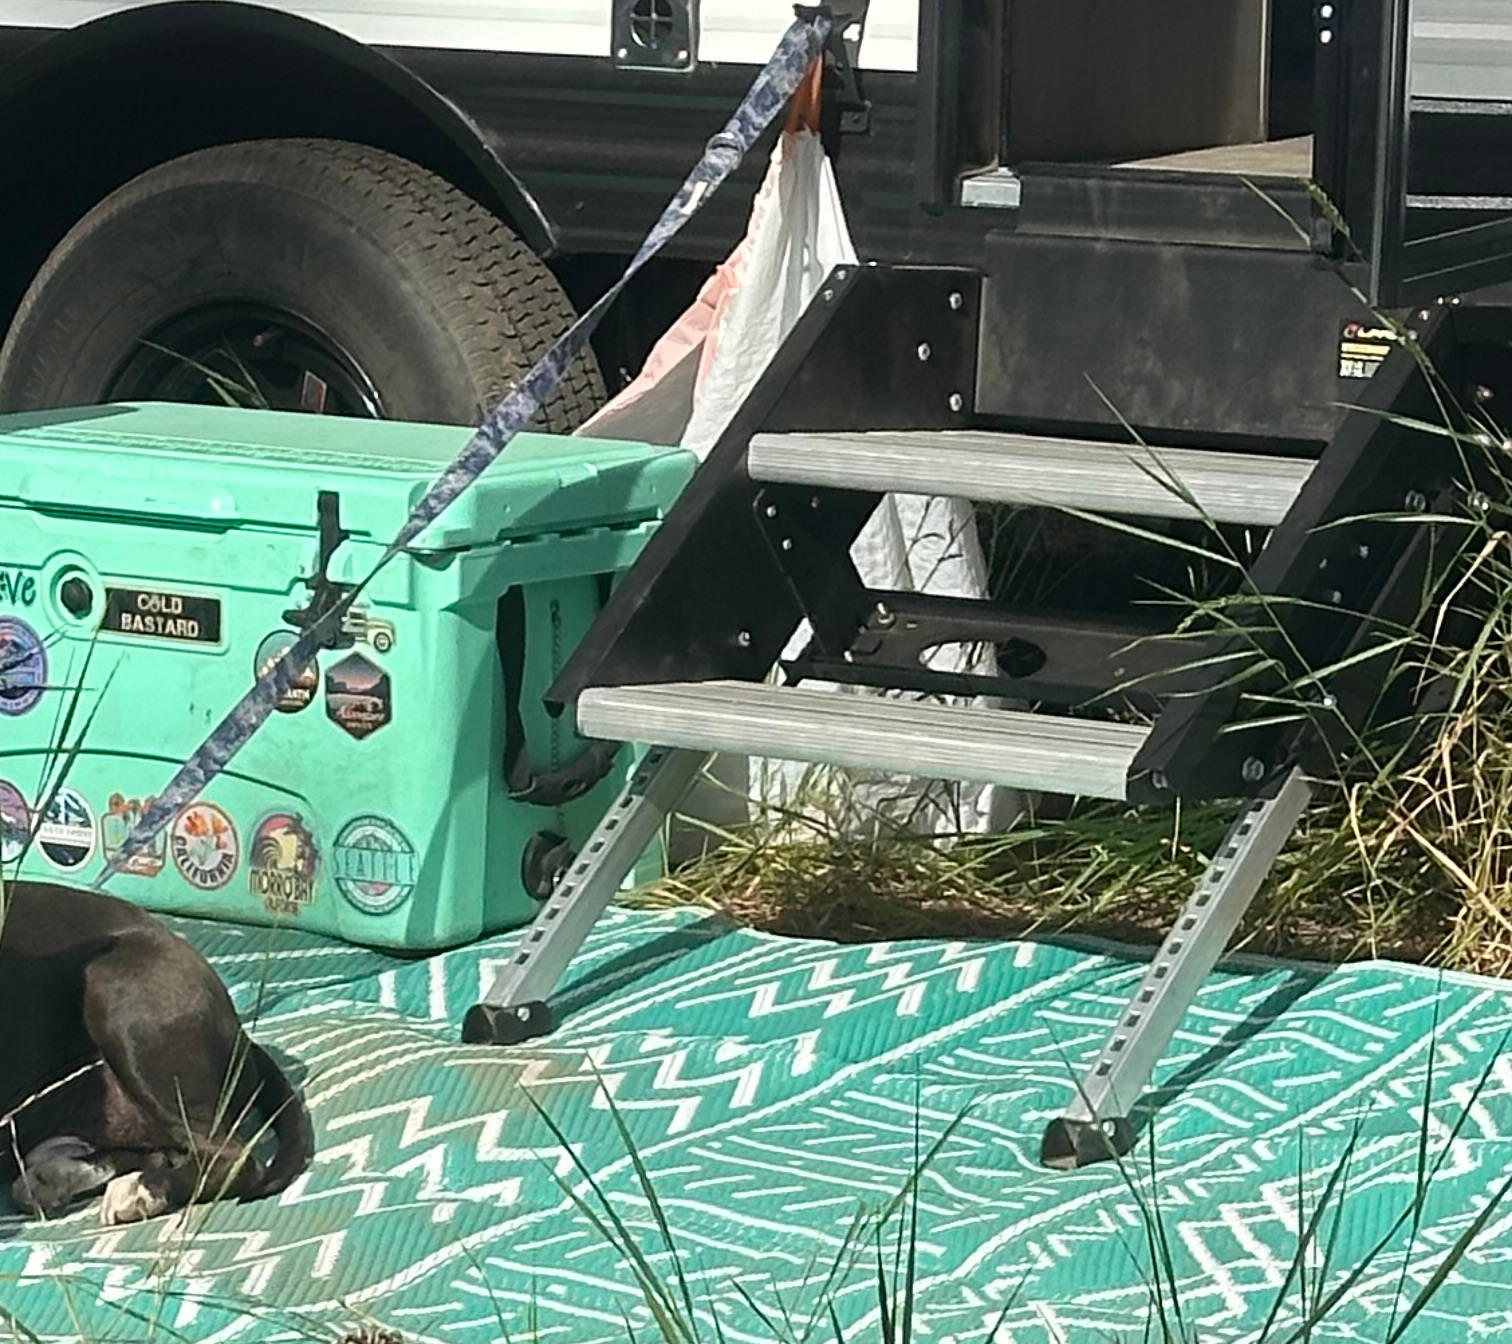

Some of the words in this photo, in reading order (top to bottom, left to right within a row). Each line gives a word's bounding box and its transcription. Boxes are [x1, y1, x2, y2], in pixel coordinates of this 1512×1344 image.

[137, 593, 183, 614] COLD
[121, 613, 199, 638] BASTARD
[174, 834, 235, 885] CALIFORNIA
